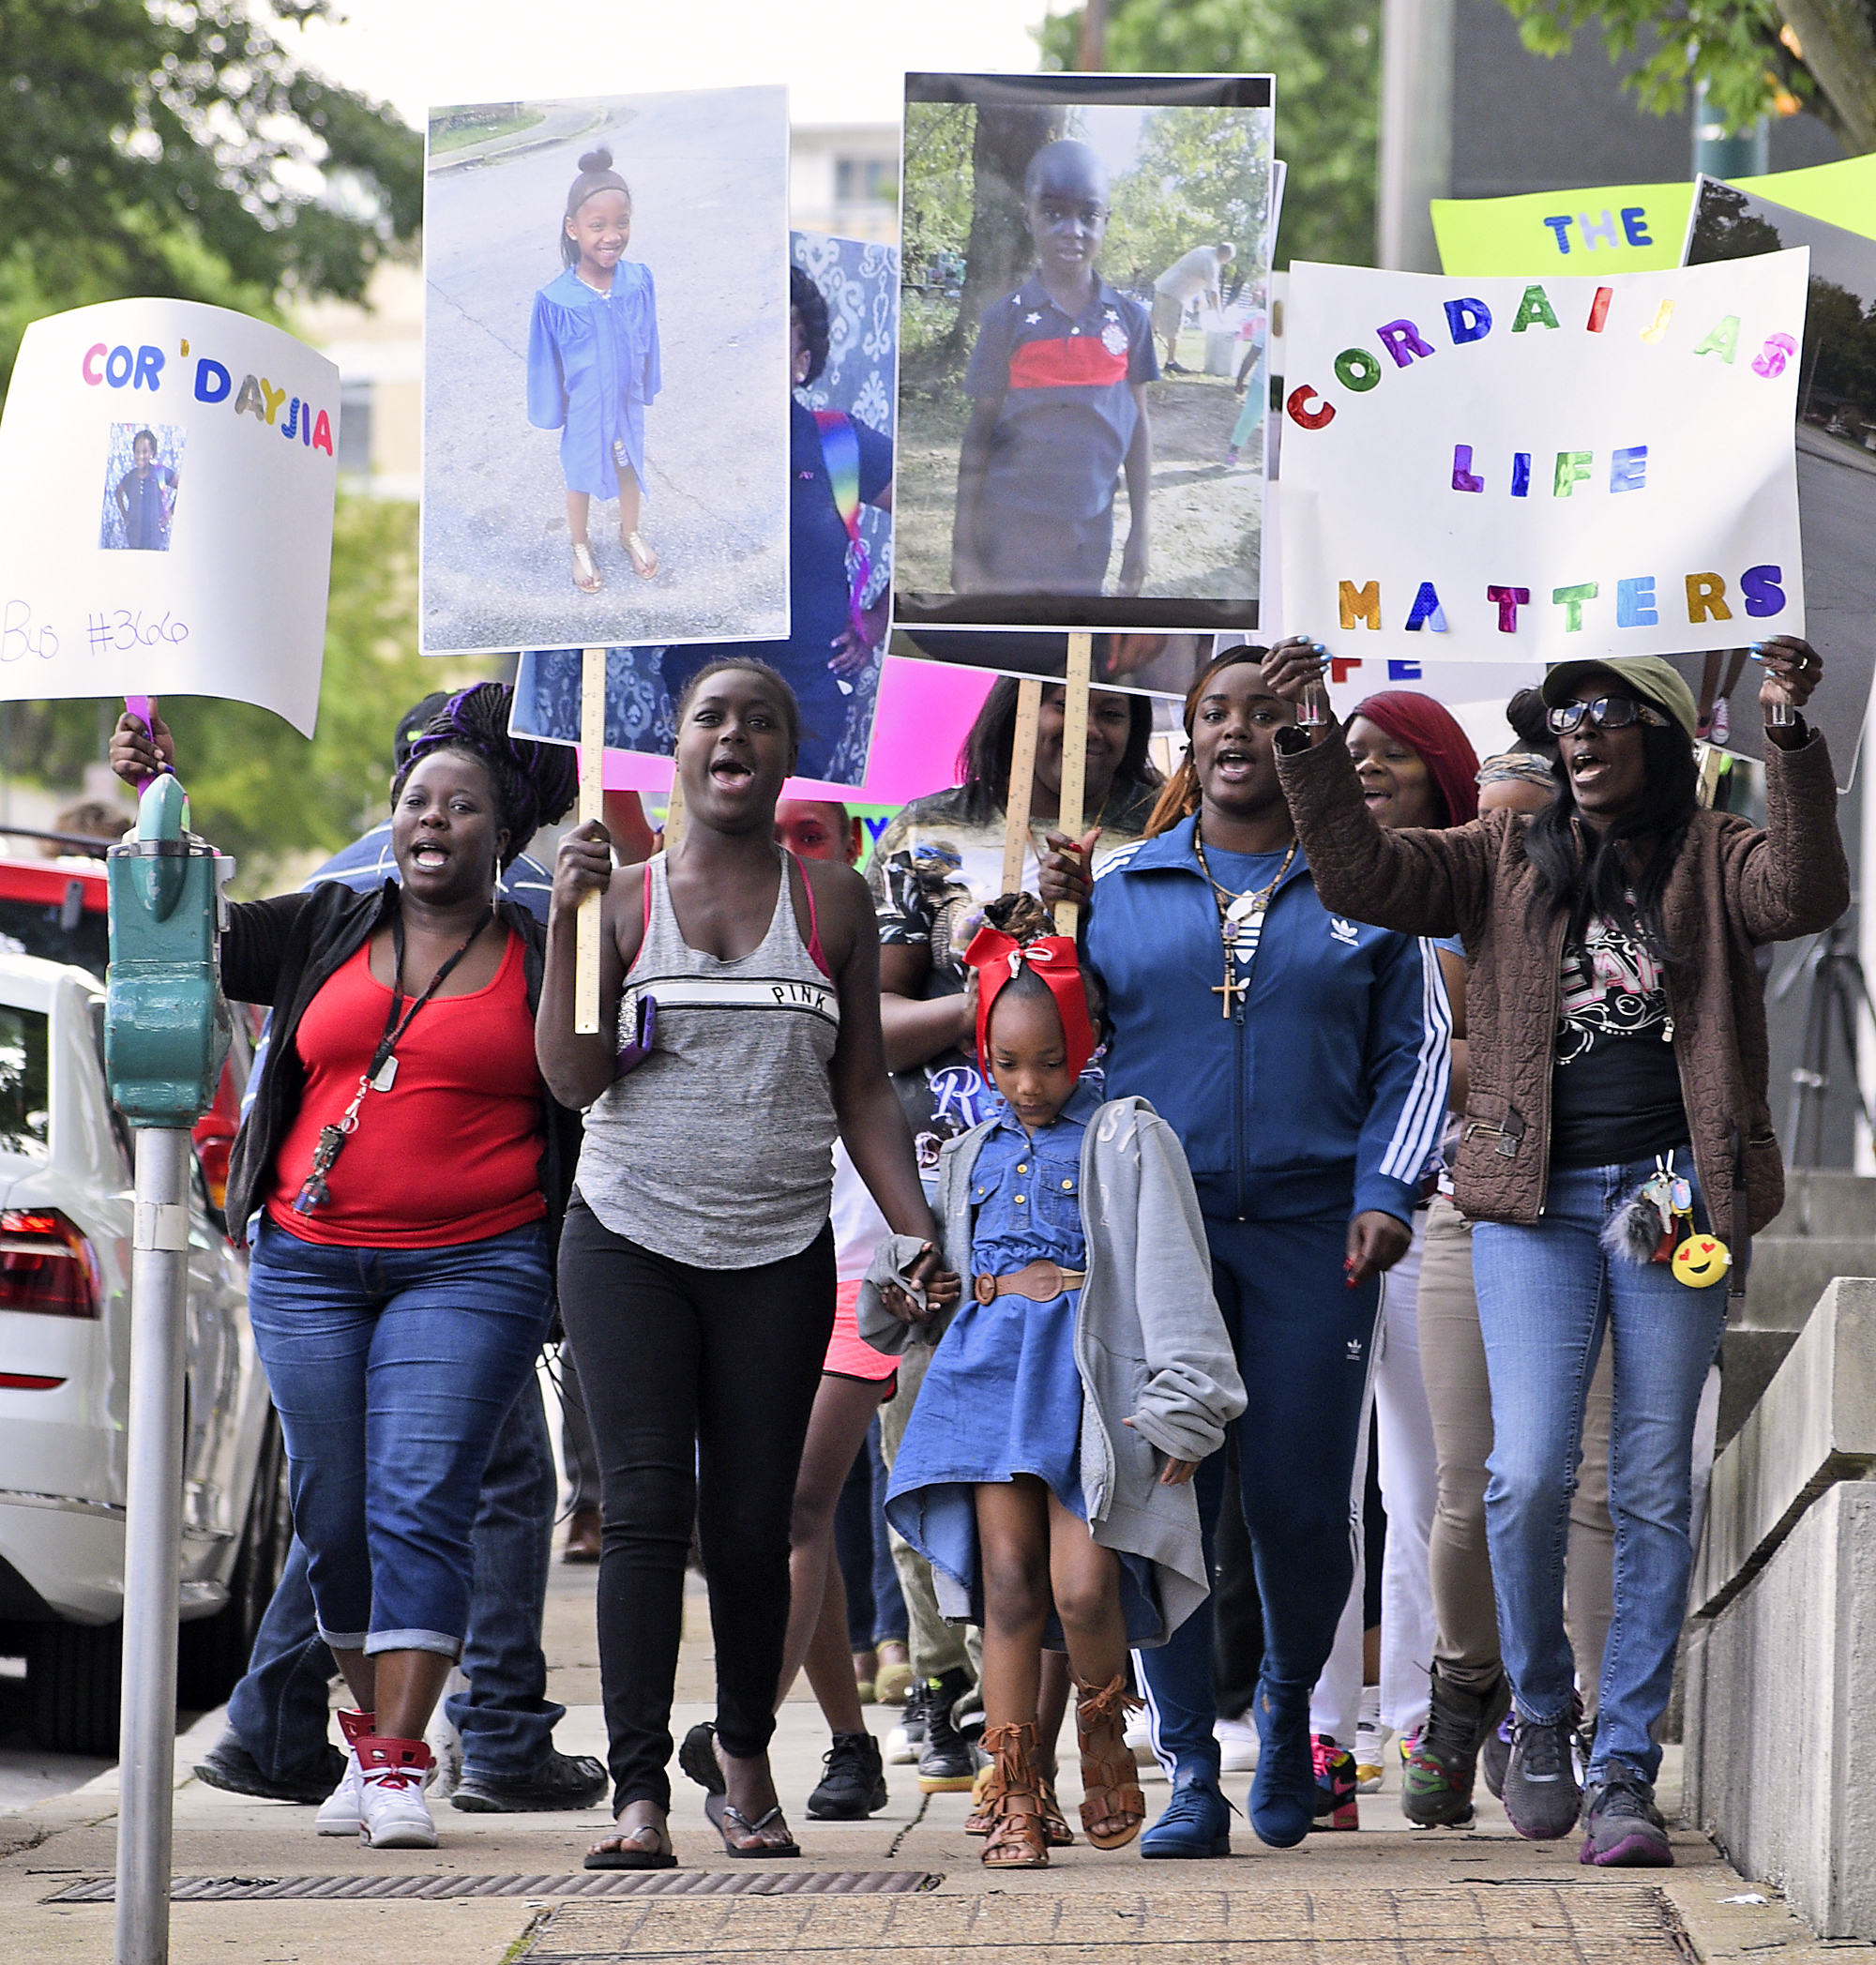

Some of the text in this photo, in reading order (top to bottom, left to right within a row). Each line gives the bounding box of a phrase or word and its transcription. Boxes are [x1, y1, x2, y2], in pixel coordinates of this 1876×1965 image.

[1544, 207, 1654, 255] THE
[1286, 284, 1799, 431] CORDAIJAS
[1451, 444, 1649, 499] LIFE
[1339, 565, 1787, 633] MATTERS
[86, 610, 189, 657] #366
[772, 985, 825, 1011] PINK
